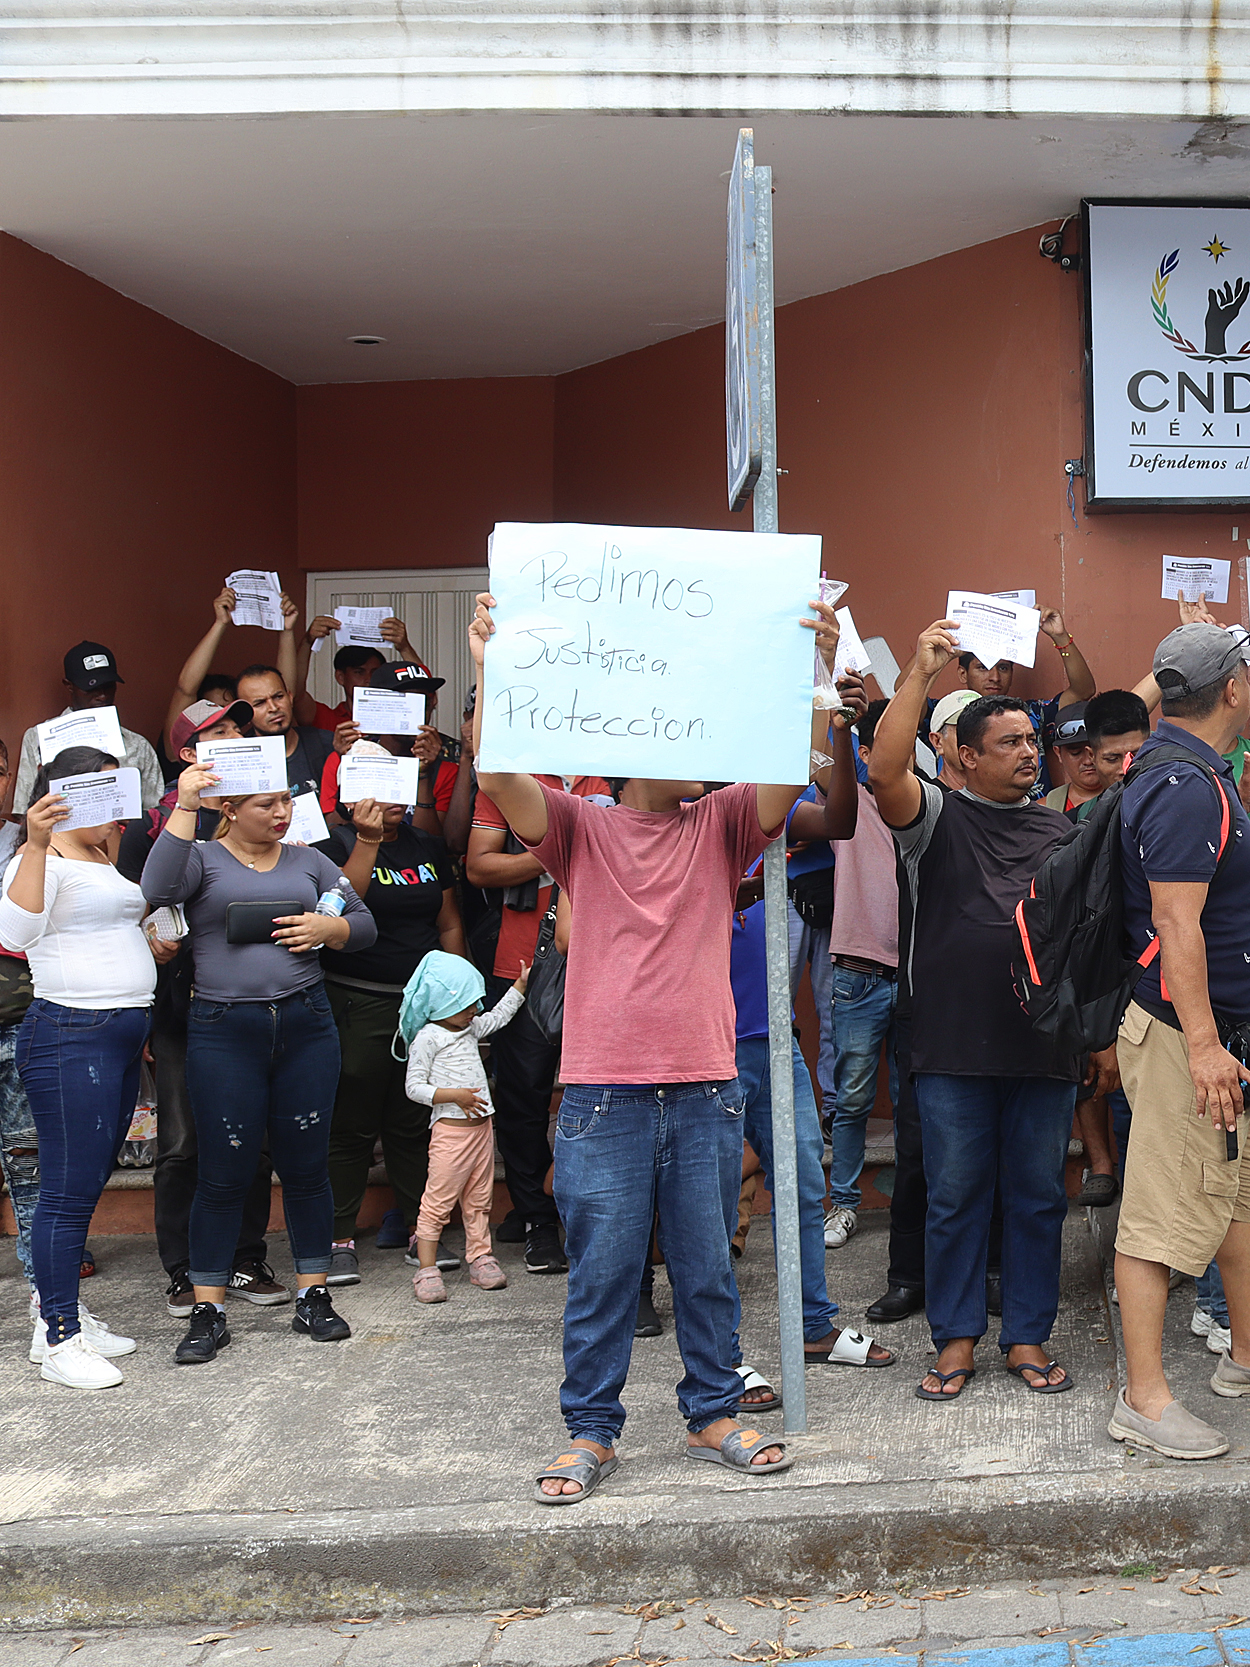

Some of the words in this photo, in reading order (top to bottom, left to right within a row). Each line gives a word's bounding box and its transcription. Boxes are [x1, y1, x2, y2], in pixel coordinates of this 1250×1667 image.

[1128, 453, 1228, 473] Defendemos
[1235, 455, 1250, 470] al
[519, 541, 713, 618] Pedimos
[394, 665, 430, 682] FILA
[493, 685, 712, 741] Proteccion.
